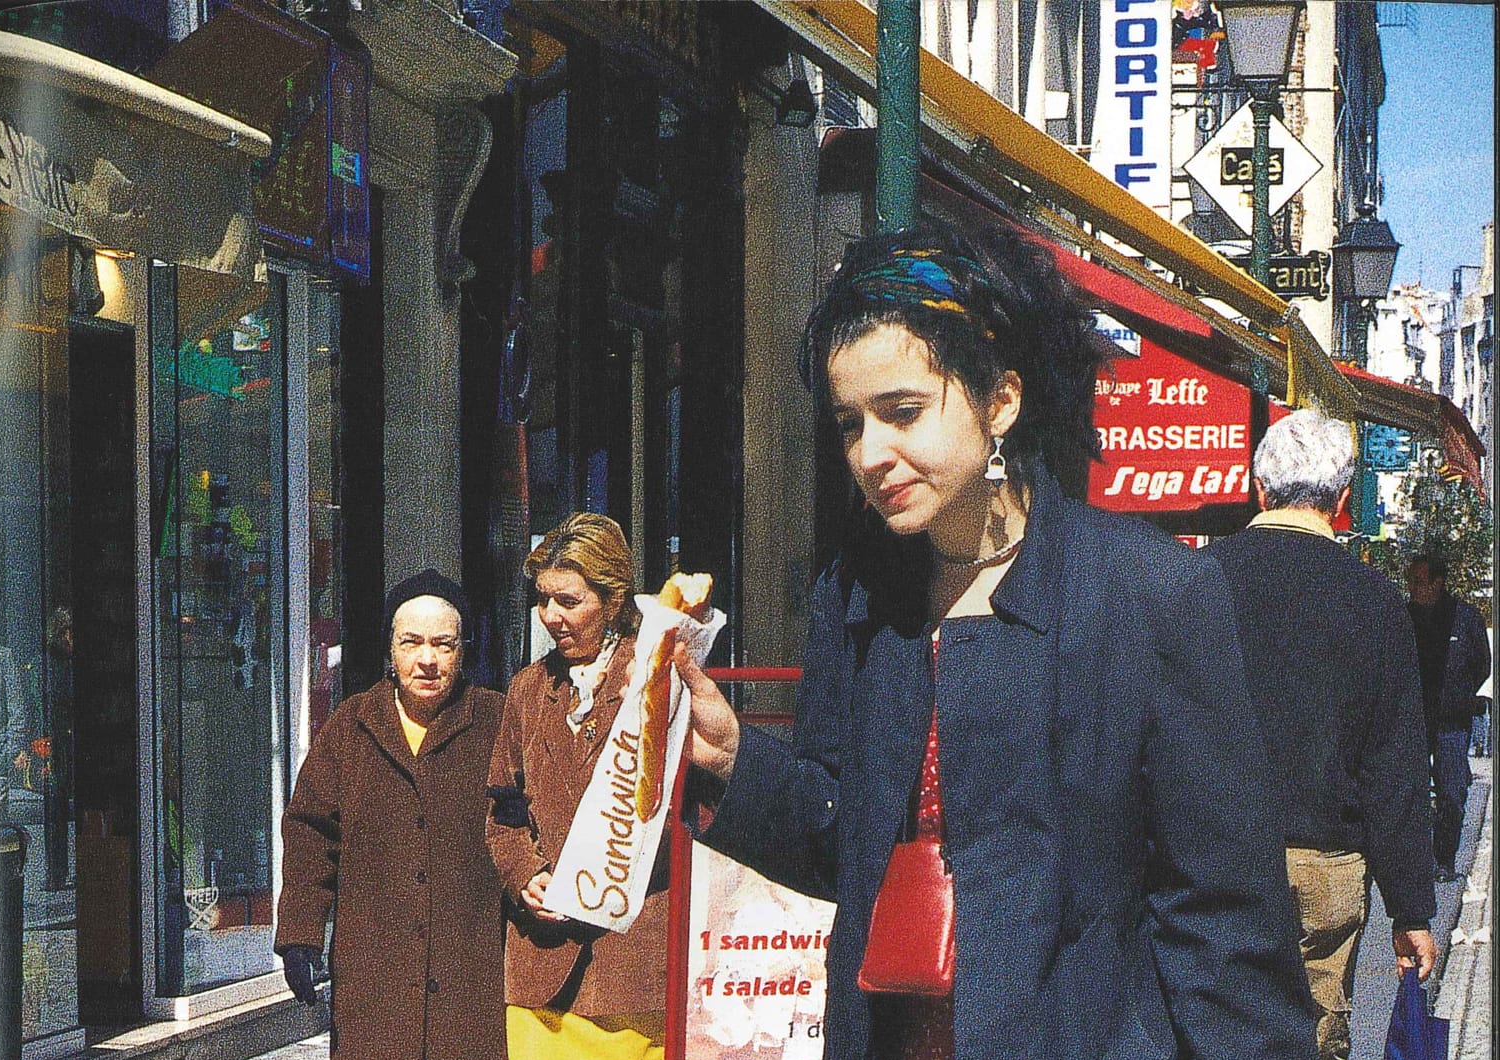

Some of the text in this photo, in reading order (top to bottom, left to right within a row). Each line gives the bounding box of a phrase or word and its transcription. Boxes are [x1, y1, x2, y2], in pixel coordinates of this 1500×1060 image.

[1223, 151, 1283, 181] Caé
[1146, 378, 1208, 405] Leffe
[1097, 425, 1246, 451] BRASSERIE
[1104, 466, 1184, 500] Sega
[575, 728, 640, 919] Sandwich
[700, 931, 711, 950] 1
[700, 976, 812, 997] 1 salade
